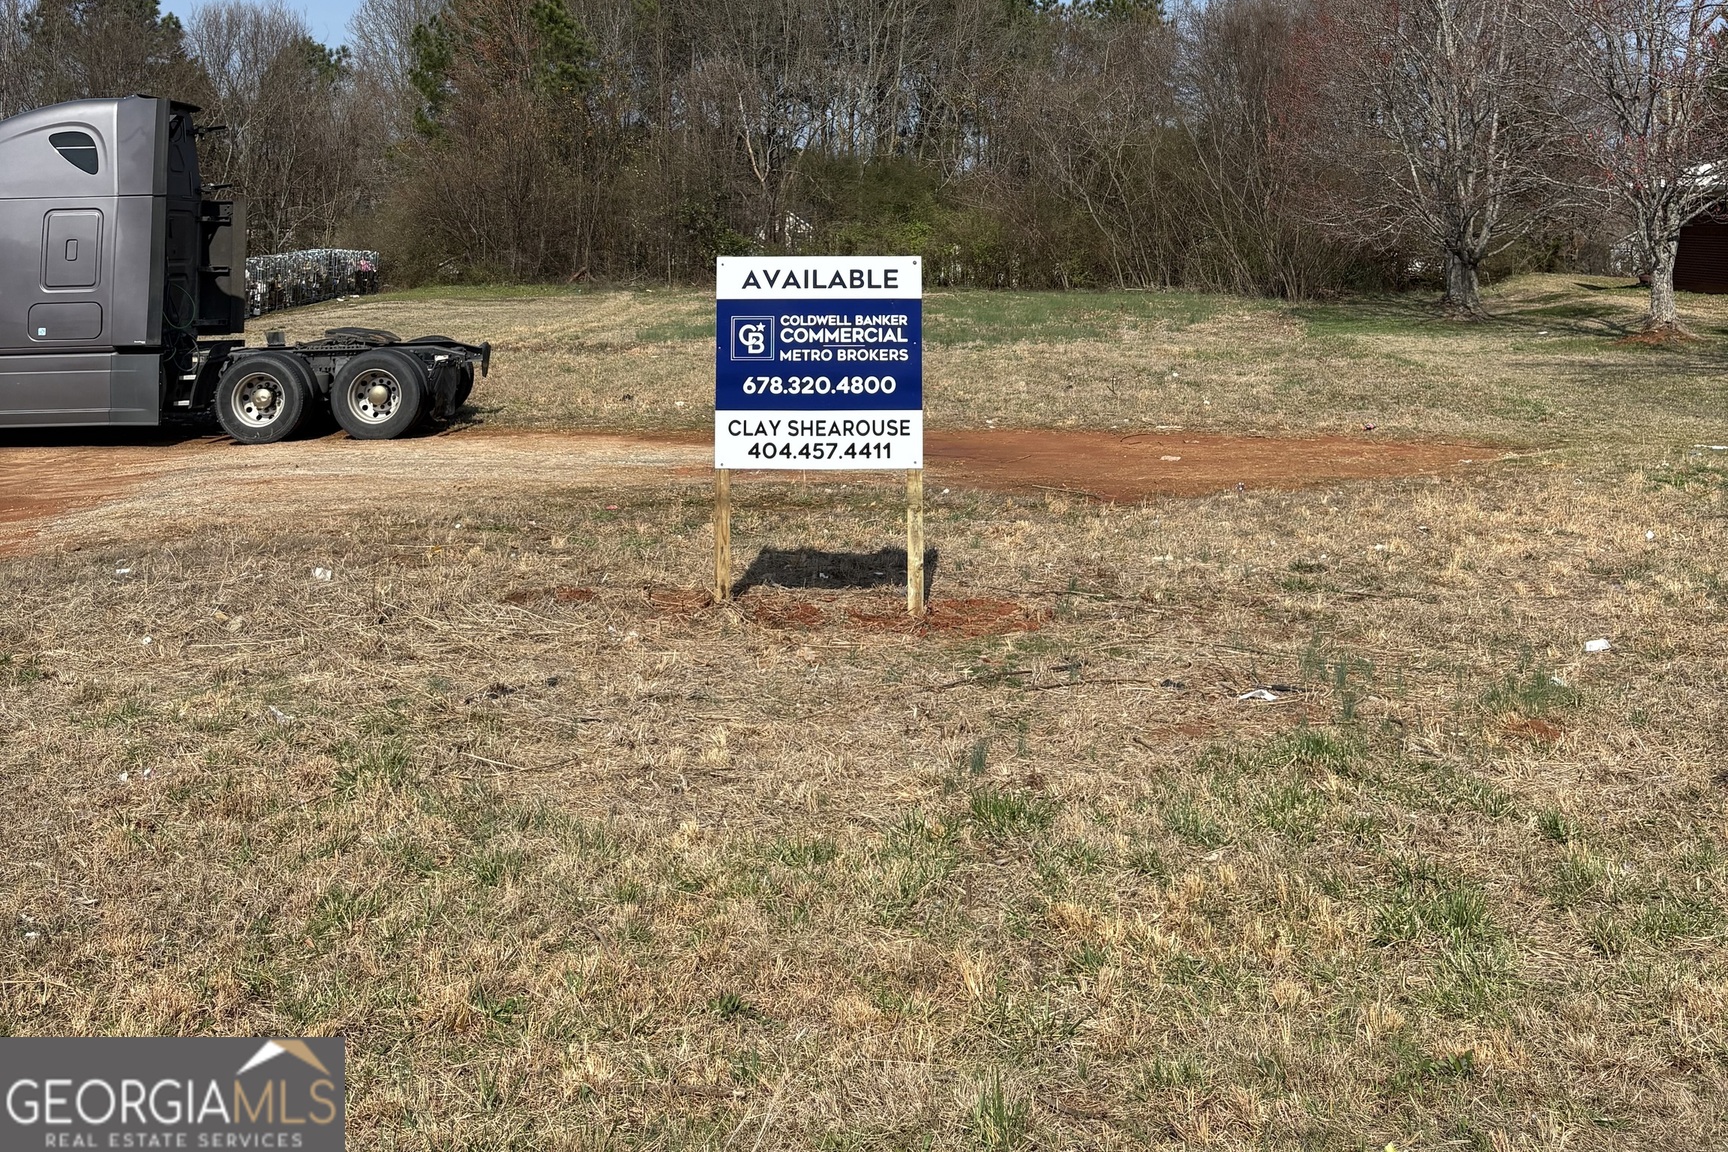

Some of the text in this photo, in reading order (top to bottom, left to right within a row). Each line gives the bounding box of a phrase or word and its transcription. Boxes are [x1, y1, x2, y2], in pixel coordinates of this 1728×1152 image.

[741, 269, 899, 289] AVAILABLE
[780, 315, 908, 326] COLDWELL BANKER
[780, 327, 909, 343] COMMERCIAL
[779, 349, 909, 361] METRO BROKERS
[742, 376, 897, 395] 678.320.4800
[728, 419, 911, 437] CLAY SHEAROUSE
[747, 442, 892, 460] 404.457.4411
